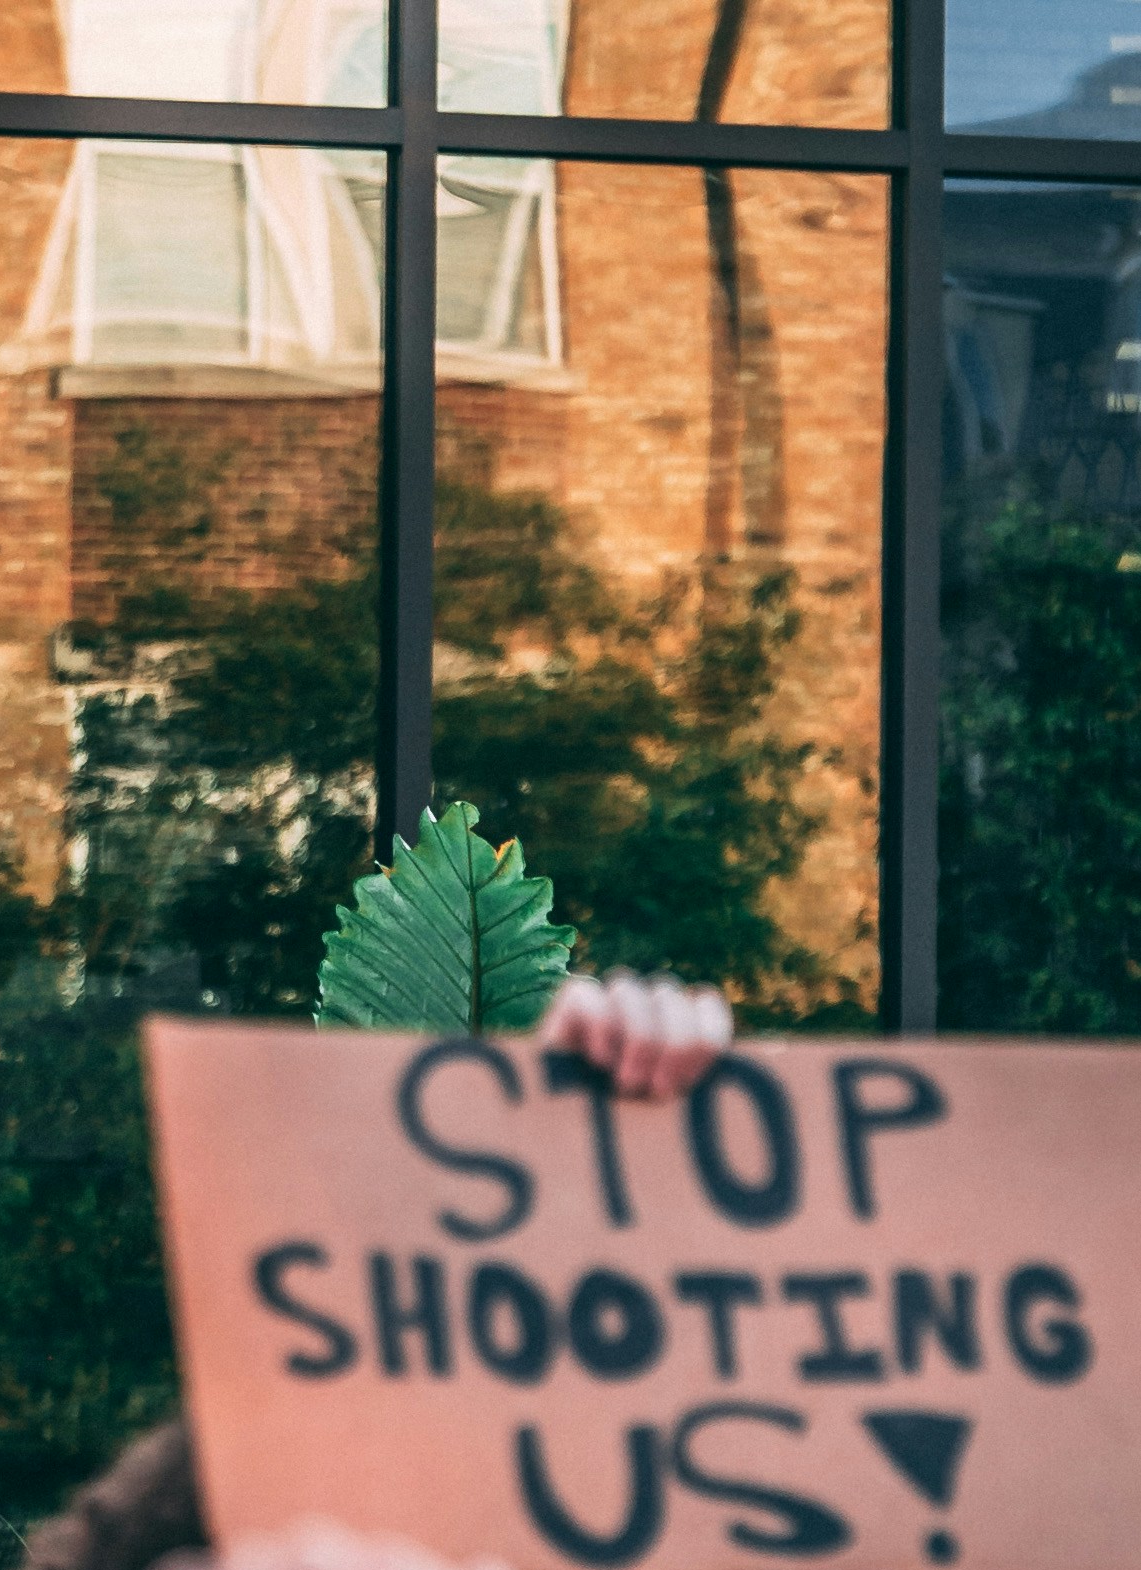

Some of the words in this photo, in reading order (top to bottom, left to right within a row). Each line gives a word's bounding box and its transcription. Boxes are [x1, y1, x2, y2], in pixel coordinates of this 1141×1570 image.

[395, 1036, 951, 1242] STOP
[249, 1240, 1094, 1386] SHOOTING
[513, 1401, 975, 1570] US!
